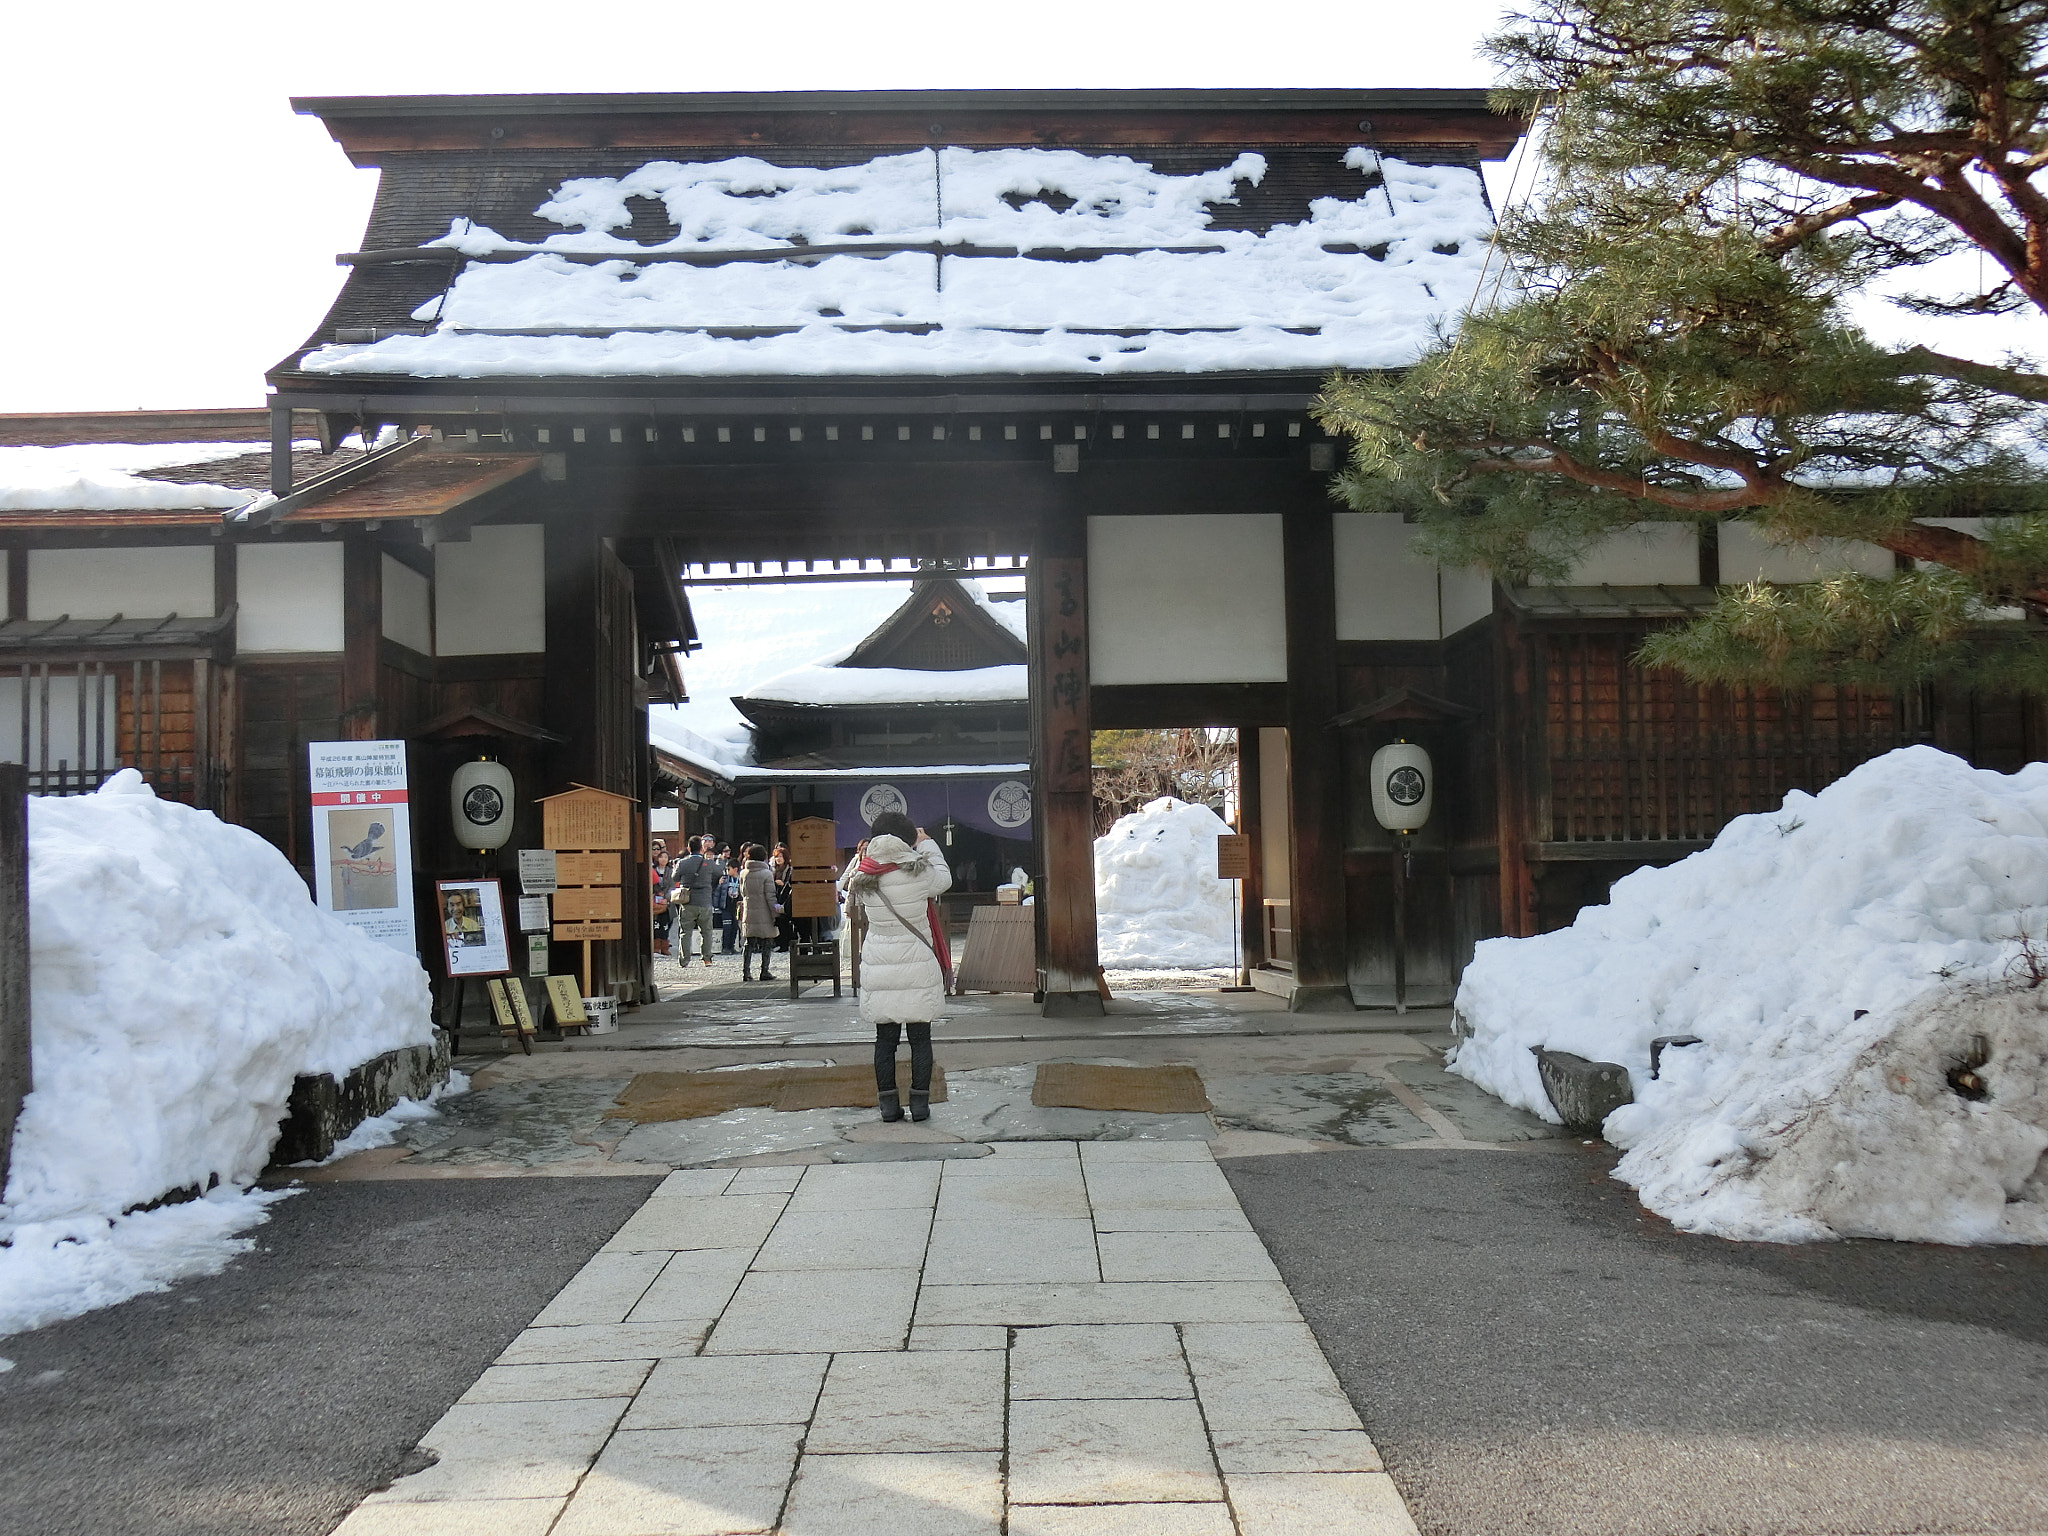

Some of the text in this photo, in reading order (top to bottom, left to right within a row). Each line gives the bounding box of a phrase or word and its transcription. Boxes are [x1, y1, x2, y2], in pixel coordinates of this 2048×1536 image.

[340, 792, 382, 804] 開催中
[451, 950, 459, 965] 5
